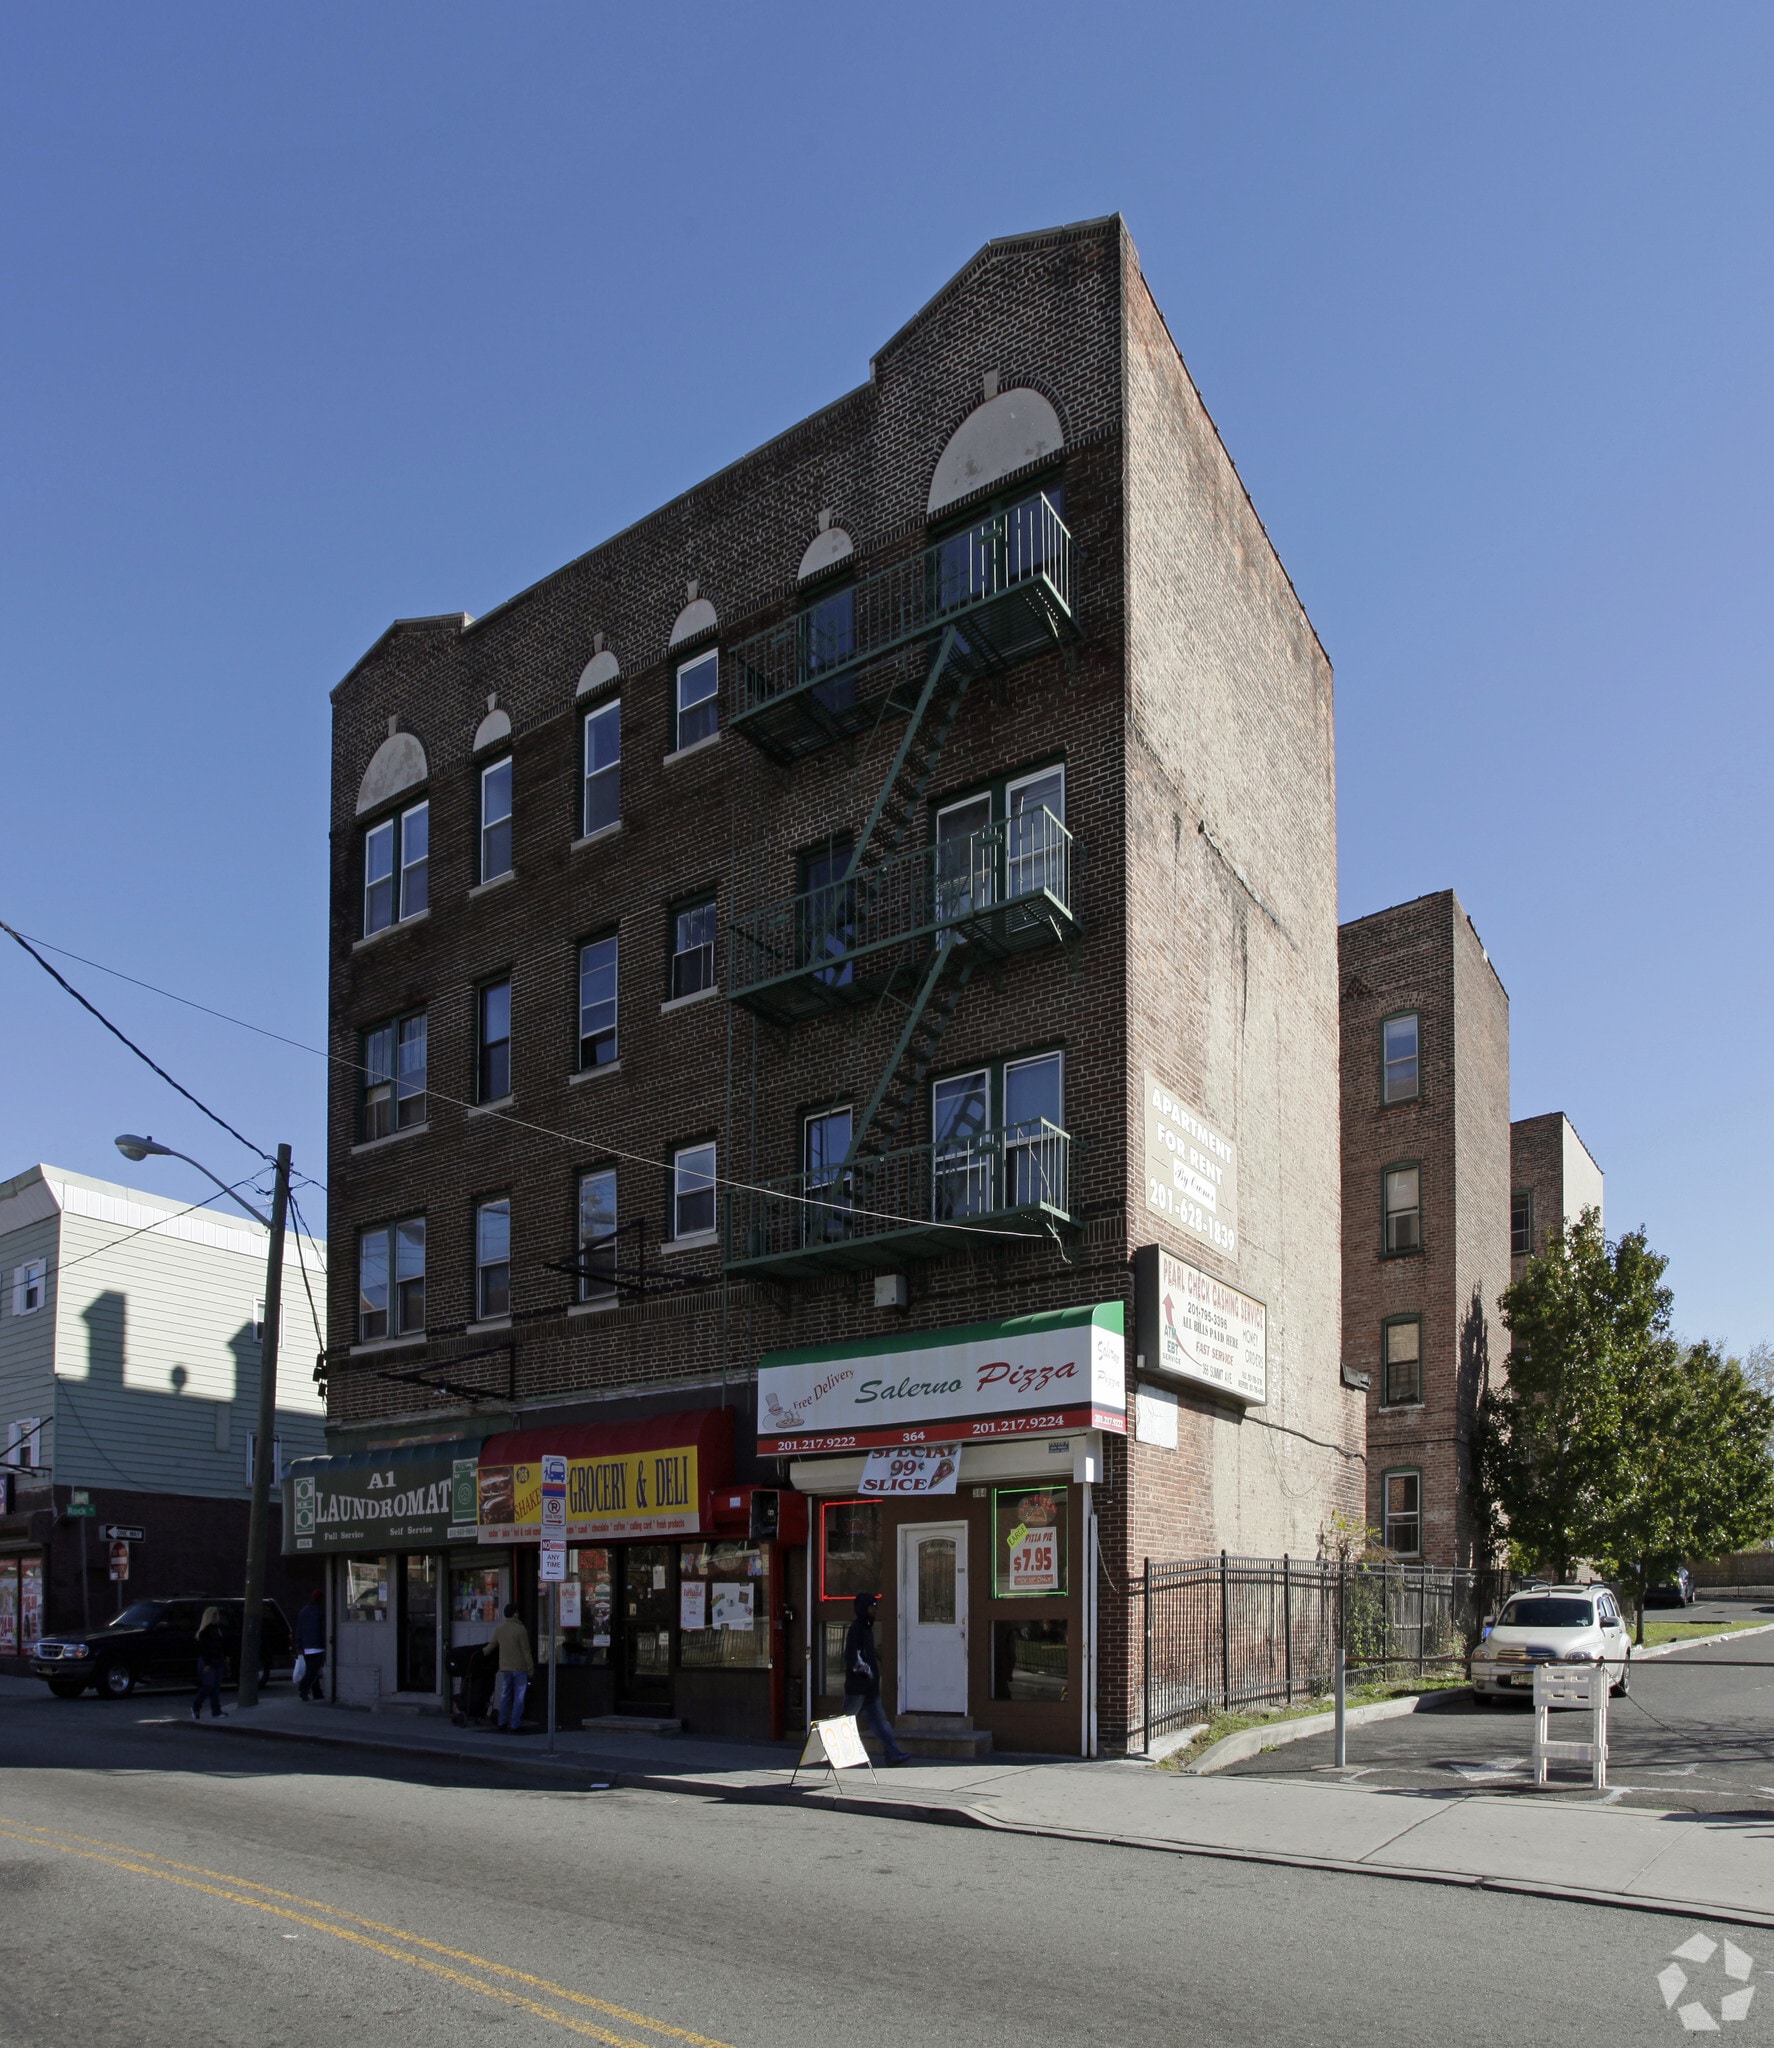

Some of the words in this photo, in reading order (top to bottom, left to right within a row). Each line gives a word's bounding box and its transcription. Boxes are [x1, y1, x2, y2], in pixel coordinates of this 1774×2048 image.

[1152, 1086, 1232, 1165] APARTMENT
[1156, 1120, 1186, 1162] FOR
[1189, 1144, 1223, 1187] RENT
[1175, 1167, 1189, 1190] By
[1150, 1176, 1236, 1252] 201-628-1839
[1163, 1257, 1185, 1294] PEARL
[1188, 1271, 1210, 1305] CHECK
[1212, 1284, 1239, 1319] CASHING
[1241, 1299, 1263, 1331] SERVICE
[1164, 1324, 1177, 1339] ATM
[1182, 1315, 1193, 1330] ALL
[1194, 1320, 1208, 1337] BILLS
[1209, 1327, 1224, 1343] PAID
[1225, 1333, 1239, 1349] HERE
[1167, 1340, 1178, 1355] EBT
[1195, 1341, 1210, 1356] FAST
[1211, 1348, 1233, 1366] SERVICE
[793, 1396, 813, 1410] Free
[813, 1368, 855, 1400] Delivery
[855, 1377, 963, 1403] Salerno
[976, 1361, 1079, 1393] Pizza
[778, 1437, 856, 1451] 201.217.9222
[903, 1431, 925, 1442] 364
[972, 1415, 1065, 1434] 201.217.9224
[872, 1445, 959, 1459] SPECIAL
[367, 1470, 397, 1490] A1
[570, 1463, 628, 1513] GROCERY
[636, 1460, 648, 1508] &
[655, 1456, 689, 1507] DELI
[863, 1479, 928, 1491] SLICE
[67, 1507, 86, 1515] Rock
[316, 1477, 452, 1523] LAUNDROMAT
[515, 1486, 542, 1521] SHAKE
[324, 1532, 339, 1542] Full
[340, 1530, 365, 1540] Service
[390, 1527, 404, 1536] Self
[407, 1524, 433, 1535] Service
[1009, 1525, 1026, 1546] LARGE
[1025, 1533, 1041, 1544] PIZZA
[1042, 1532, 1053, 1542] PIE
[543, 1541, 550, 1550] NO
[1013, 1547, 1052, 1573] $7.95
